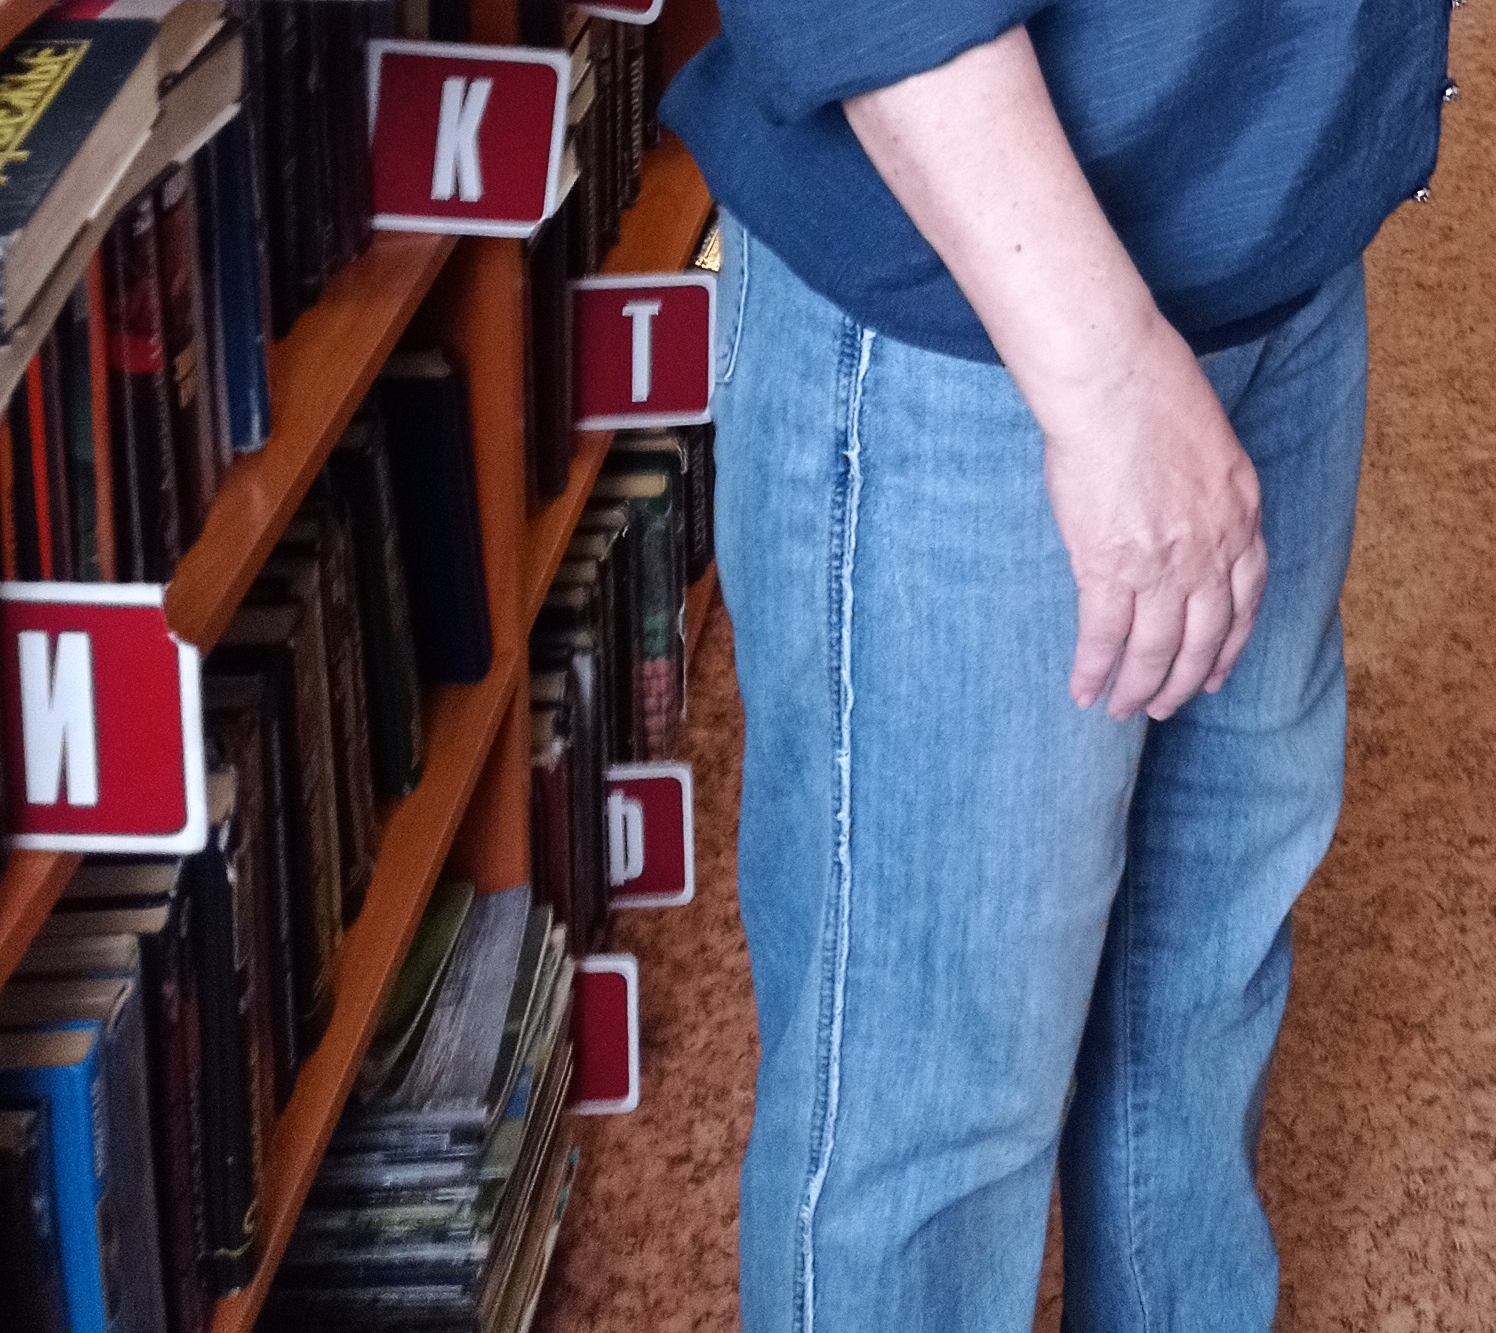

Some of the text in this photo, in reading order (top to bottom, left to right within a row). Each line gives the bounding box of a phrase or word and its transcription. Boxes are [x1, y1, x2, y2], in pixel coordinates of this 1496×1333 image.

[430, 76, 493, 203] К
[622, 300, 662, 403] Т
[17, 629, 99, 807] И
